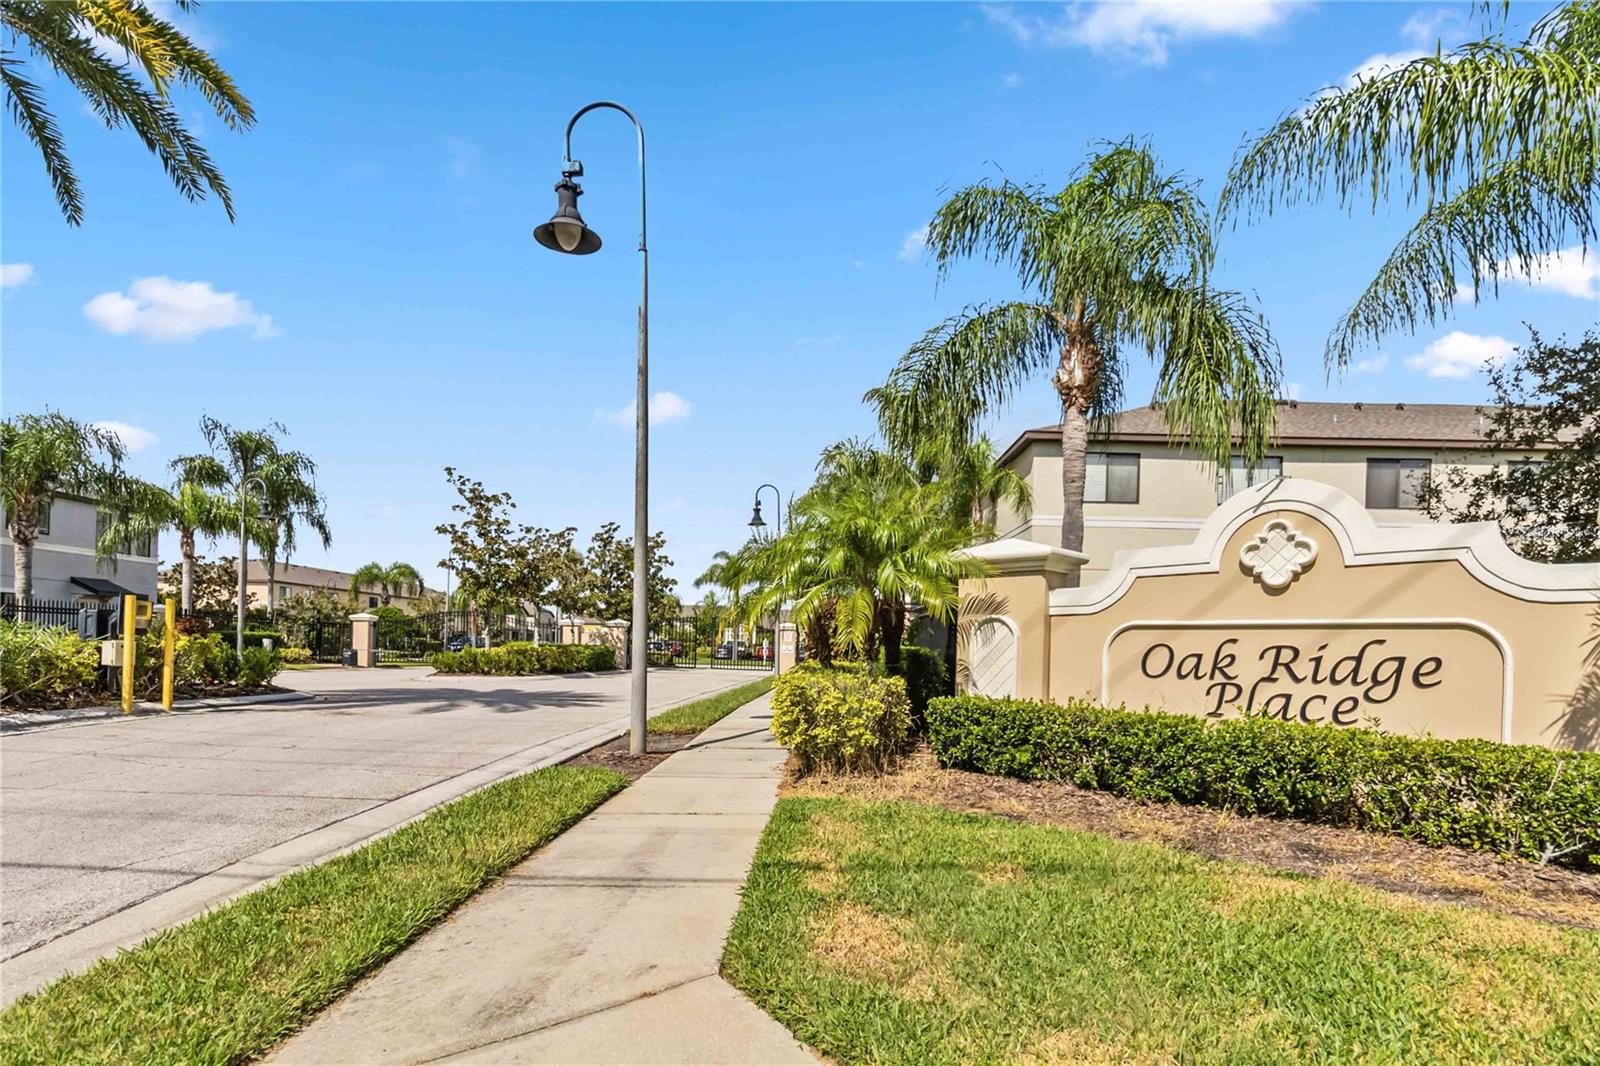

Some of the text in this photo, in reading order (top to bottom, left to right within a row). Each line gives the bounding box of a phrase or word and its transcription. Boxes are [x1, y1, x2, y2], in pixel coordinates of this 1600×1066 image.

[1140, 638, 1443, 704] Oak Ridge
[1205, 677, 1360, 726] Place
